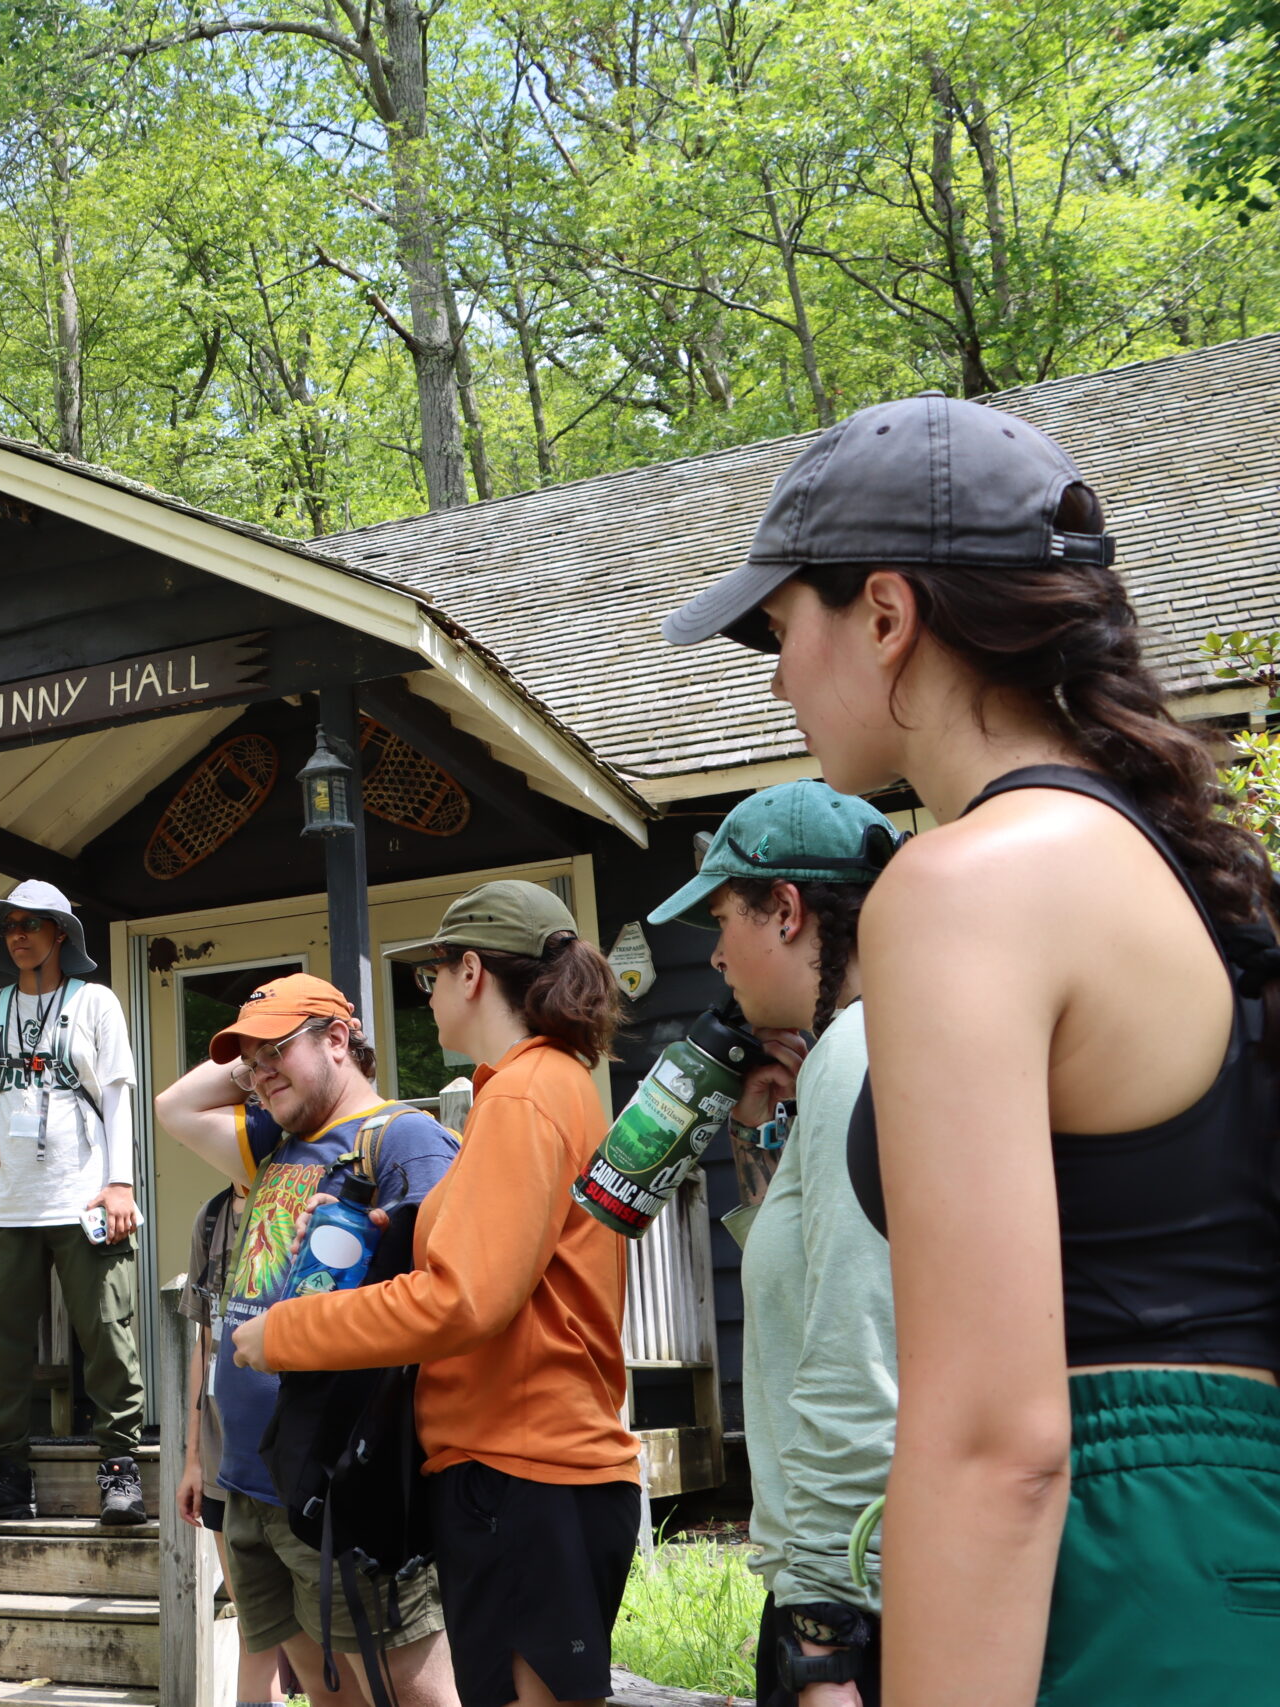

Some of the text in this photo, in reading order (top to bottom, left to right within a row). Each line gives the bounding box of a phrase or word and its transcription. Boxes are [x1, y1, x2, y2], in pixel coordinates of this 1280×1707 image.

[108, 655, 210, 706] HALL
[661, 1103, 686, 1126] Wilson
[585, 1181, 640, 1225] SUNRISE
[589, 1158, 638, 1204] CADILLAC
